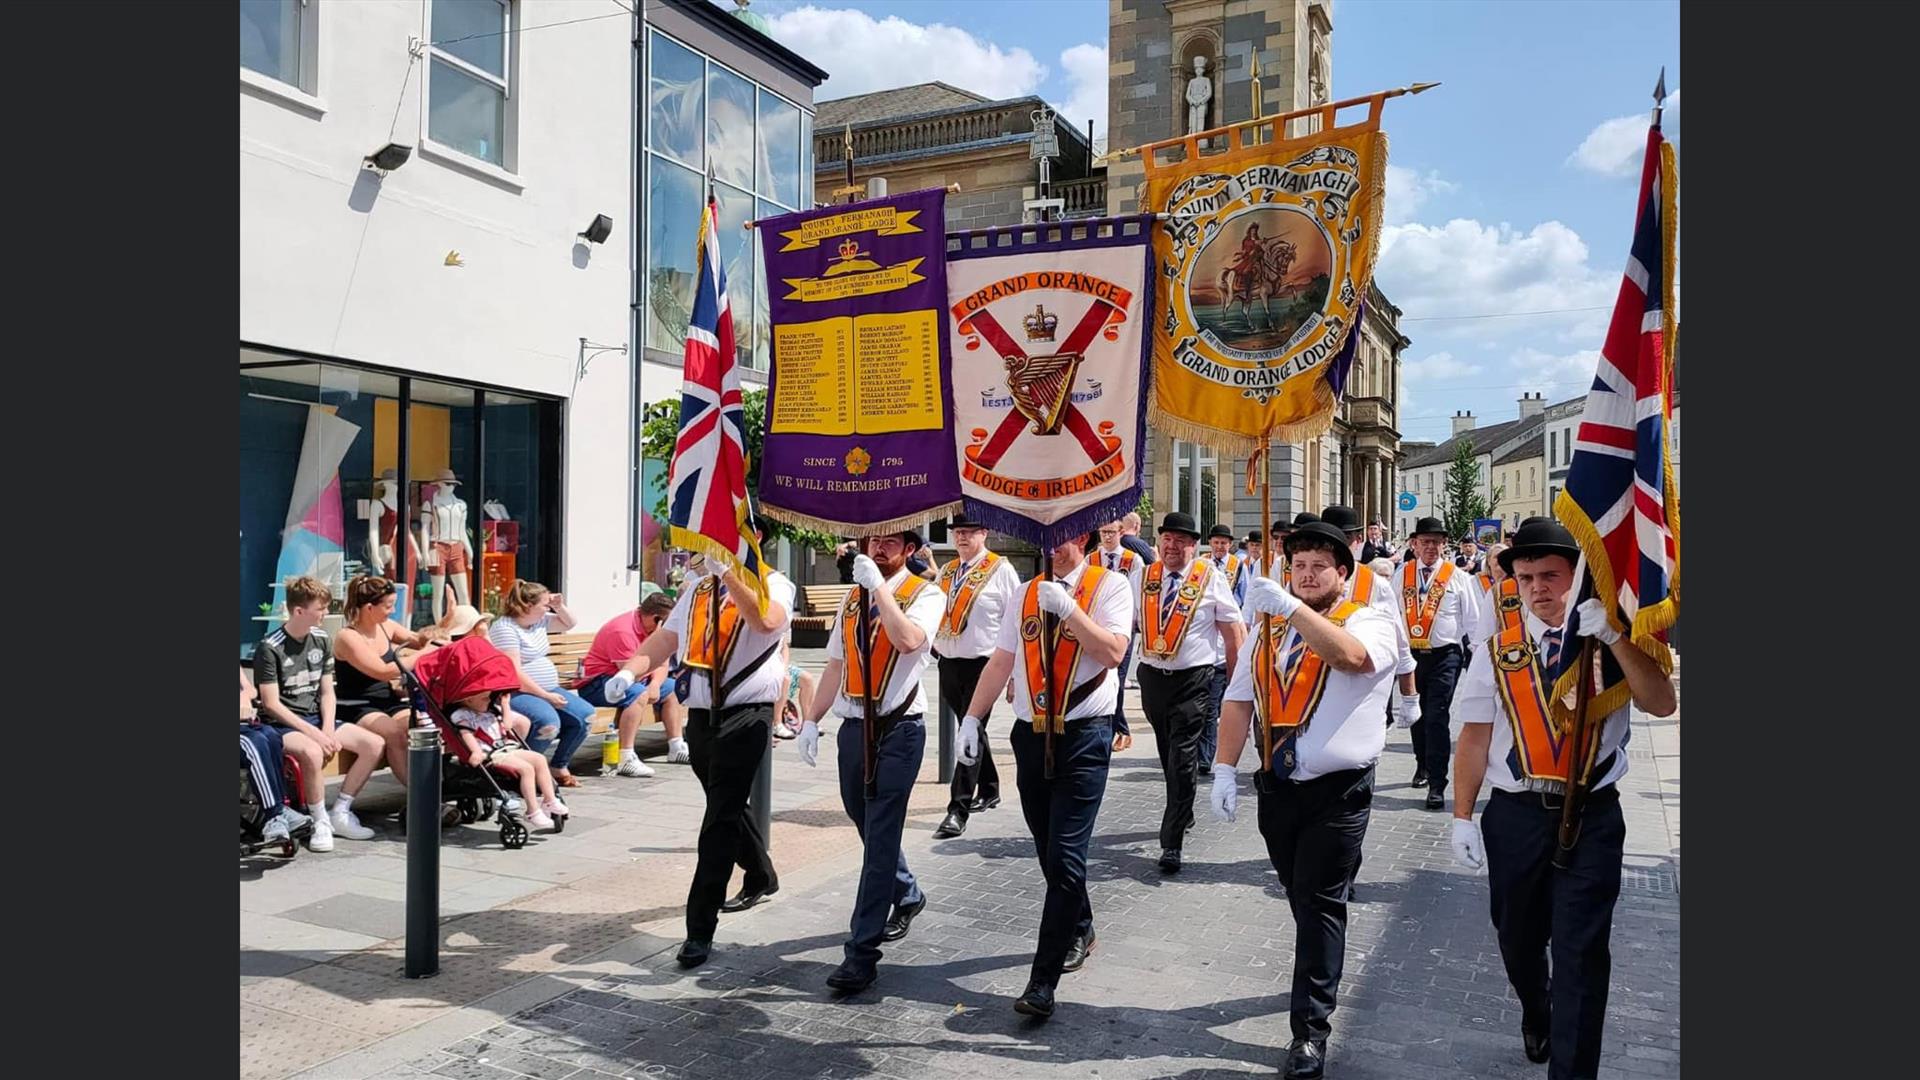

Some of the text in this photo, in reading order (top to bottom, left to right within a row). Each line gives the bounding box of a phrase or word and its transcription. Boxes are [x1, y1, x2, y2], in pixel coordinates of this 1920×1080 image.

[1173, 167, 1352, 228] COUNTY FERMANAGH
[802, 218, 896, 240] GRAND ORANGE LODGE
[803, 209, 894, 231] COUNTY FERMANAGH
[965, 272, 1119, 311] GRAND ORANGE
[1182, 326, 1339, 386] GRAND ORANGE LODGE
[1075, 391, 1099, 403] 1798
[803, 458, 837, 467] SINCE
[881, 457, 904, 467] 1795
[775, 473, 929, 493] WE WILL REMEMBER THEM
[972, 469, 1023, 498] LODGE
[1046, 464, 1115, 498] IRELAND
